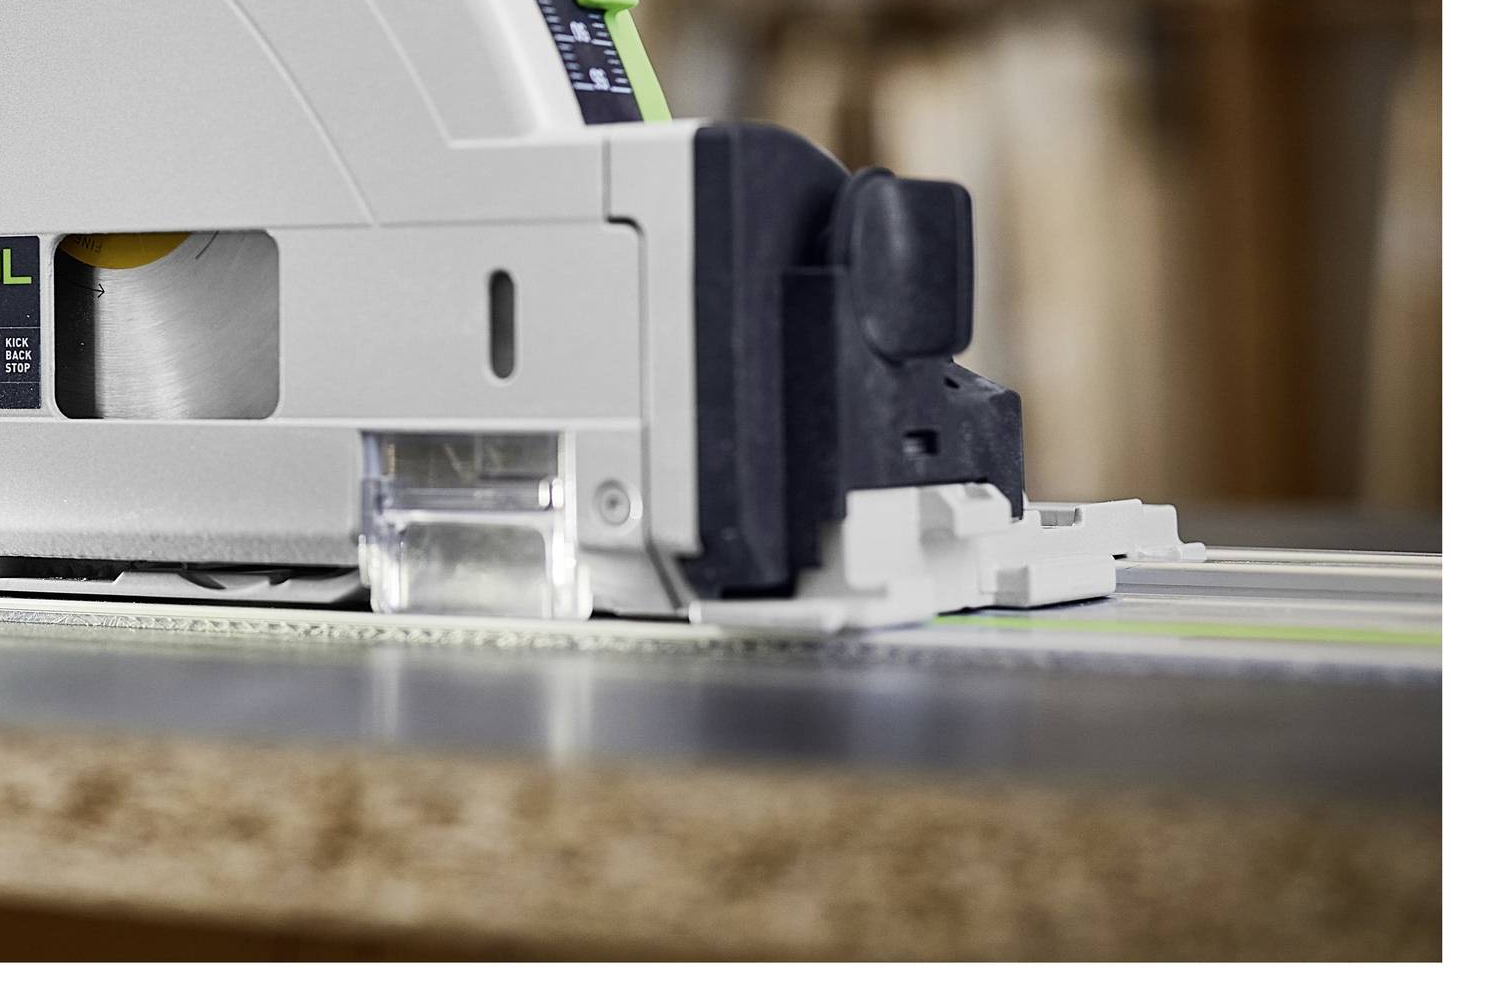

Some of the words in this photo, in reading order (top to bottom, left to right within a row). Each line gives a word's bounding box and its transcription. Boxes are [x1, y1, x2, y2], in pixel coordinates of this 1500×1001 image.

[570, 21, 592, 43] 50
[589, 67, 611, 91] 55
[5, 337, 29, 348] KICK
[5, 350, 32, 361] BACK
[5, 362, 31, 373] STOP
